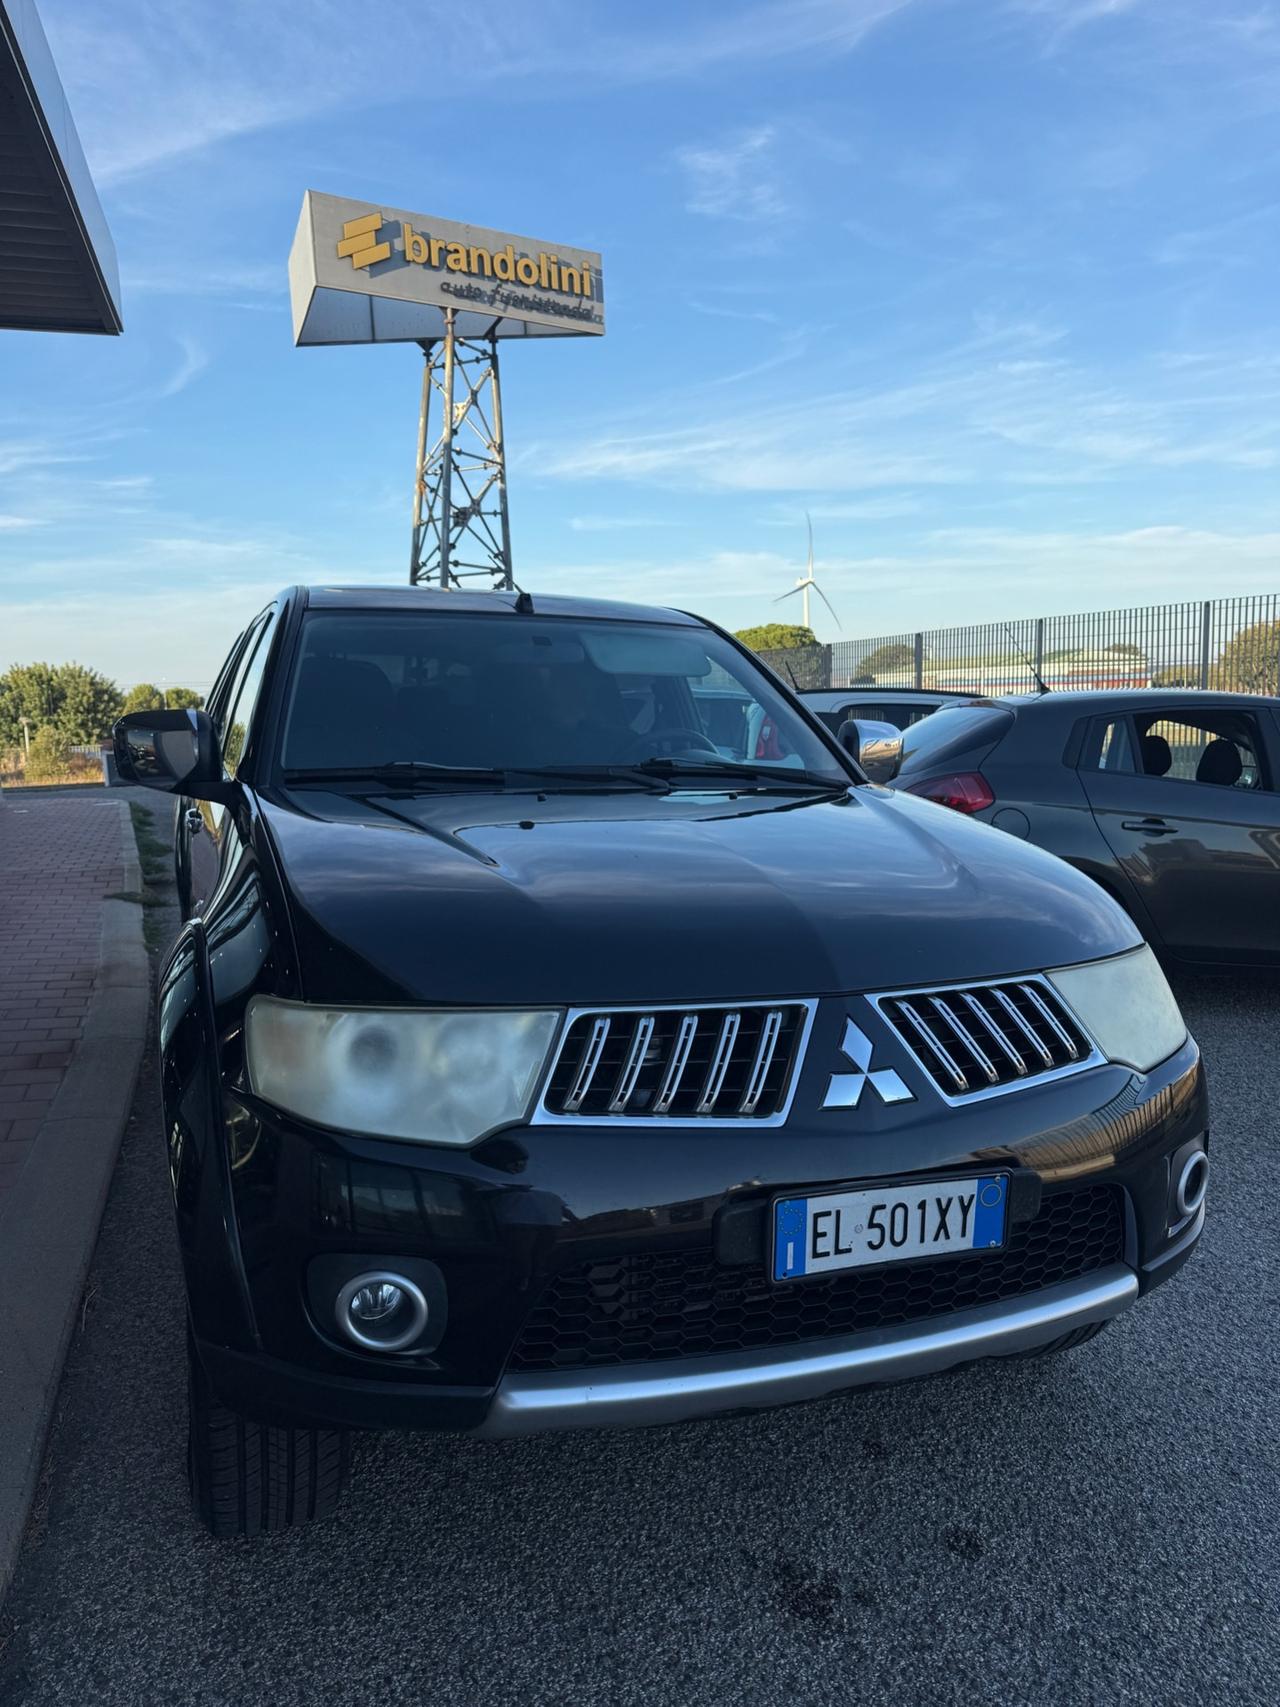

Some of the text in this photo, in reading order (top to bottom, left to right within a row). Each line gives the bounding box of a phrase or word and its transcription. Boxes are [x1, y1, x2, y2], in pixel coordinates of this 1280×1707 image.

[402, 223, 592, 297] brandolini
[811, 1193, 976, 1260] EL 501XY
